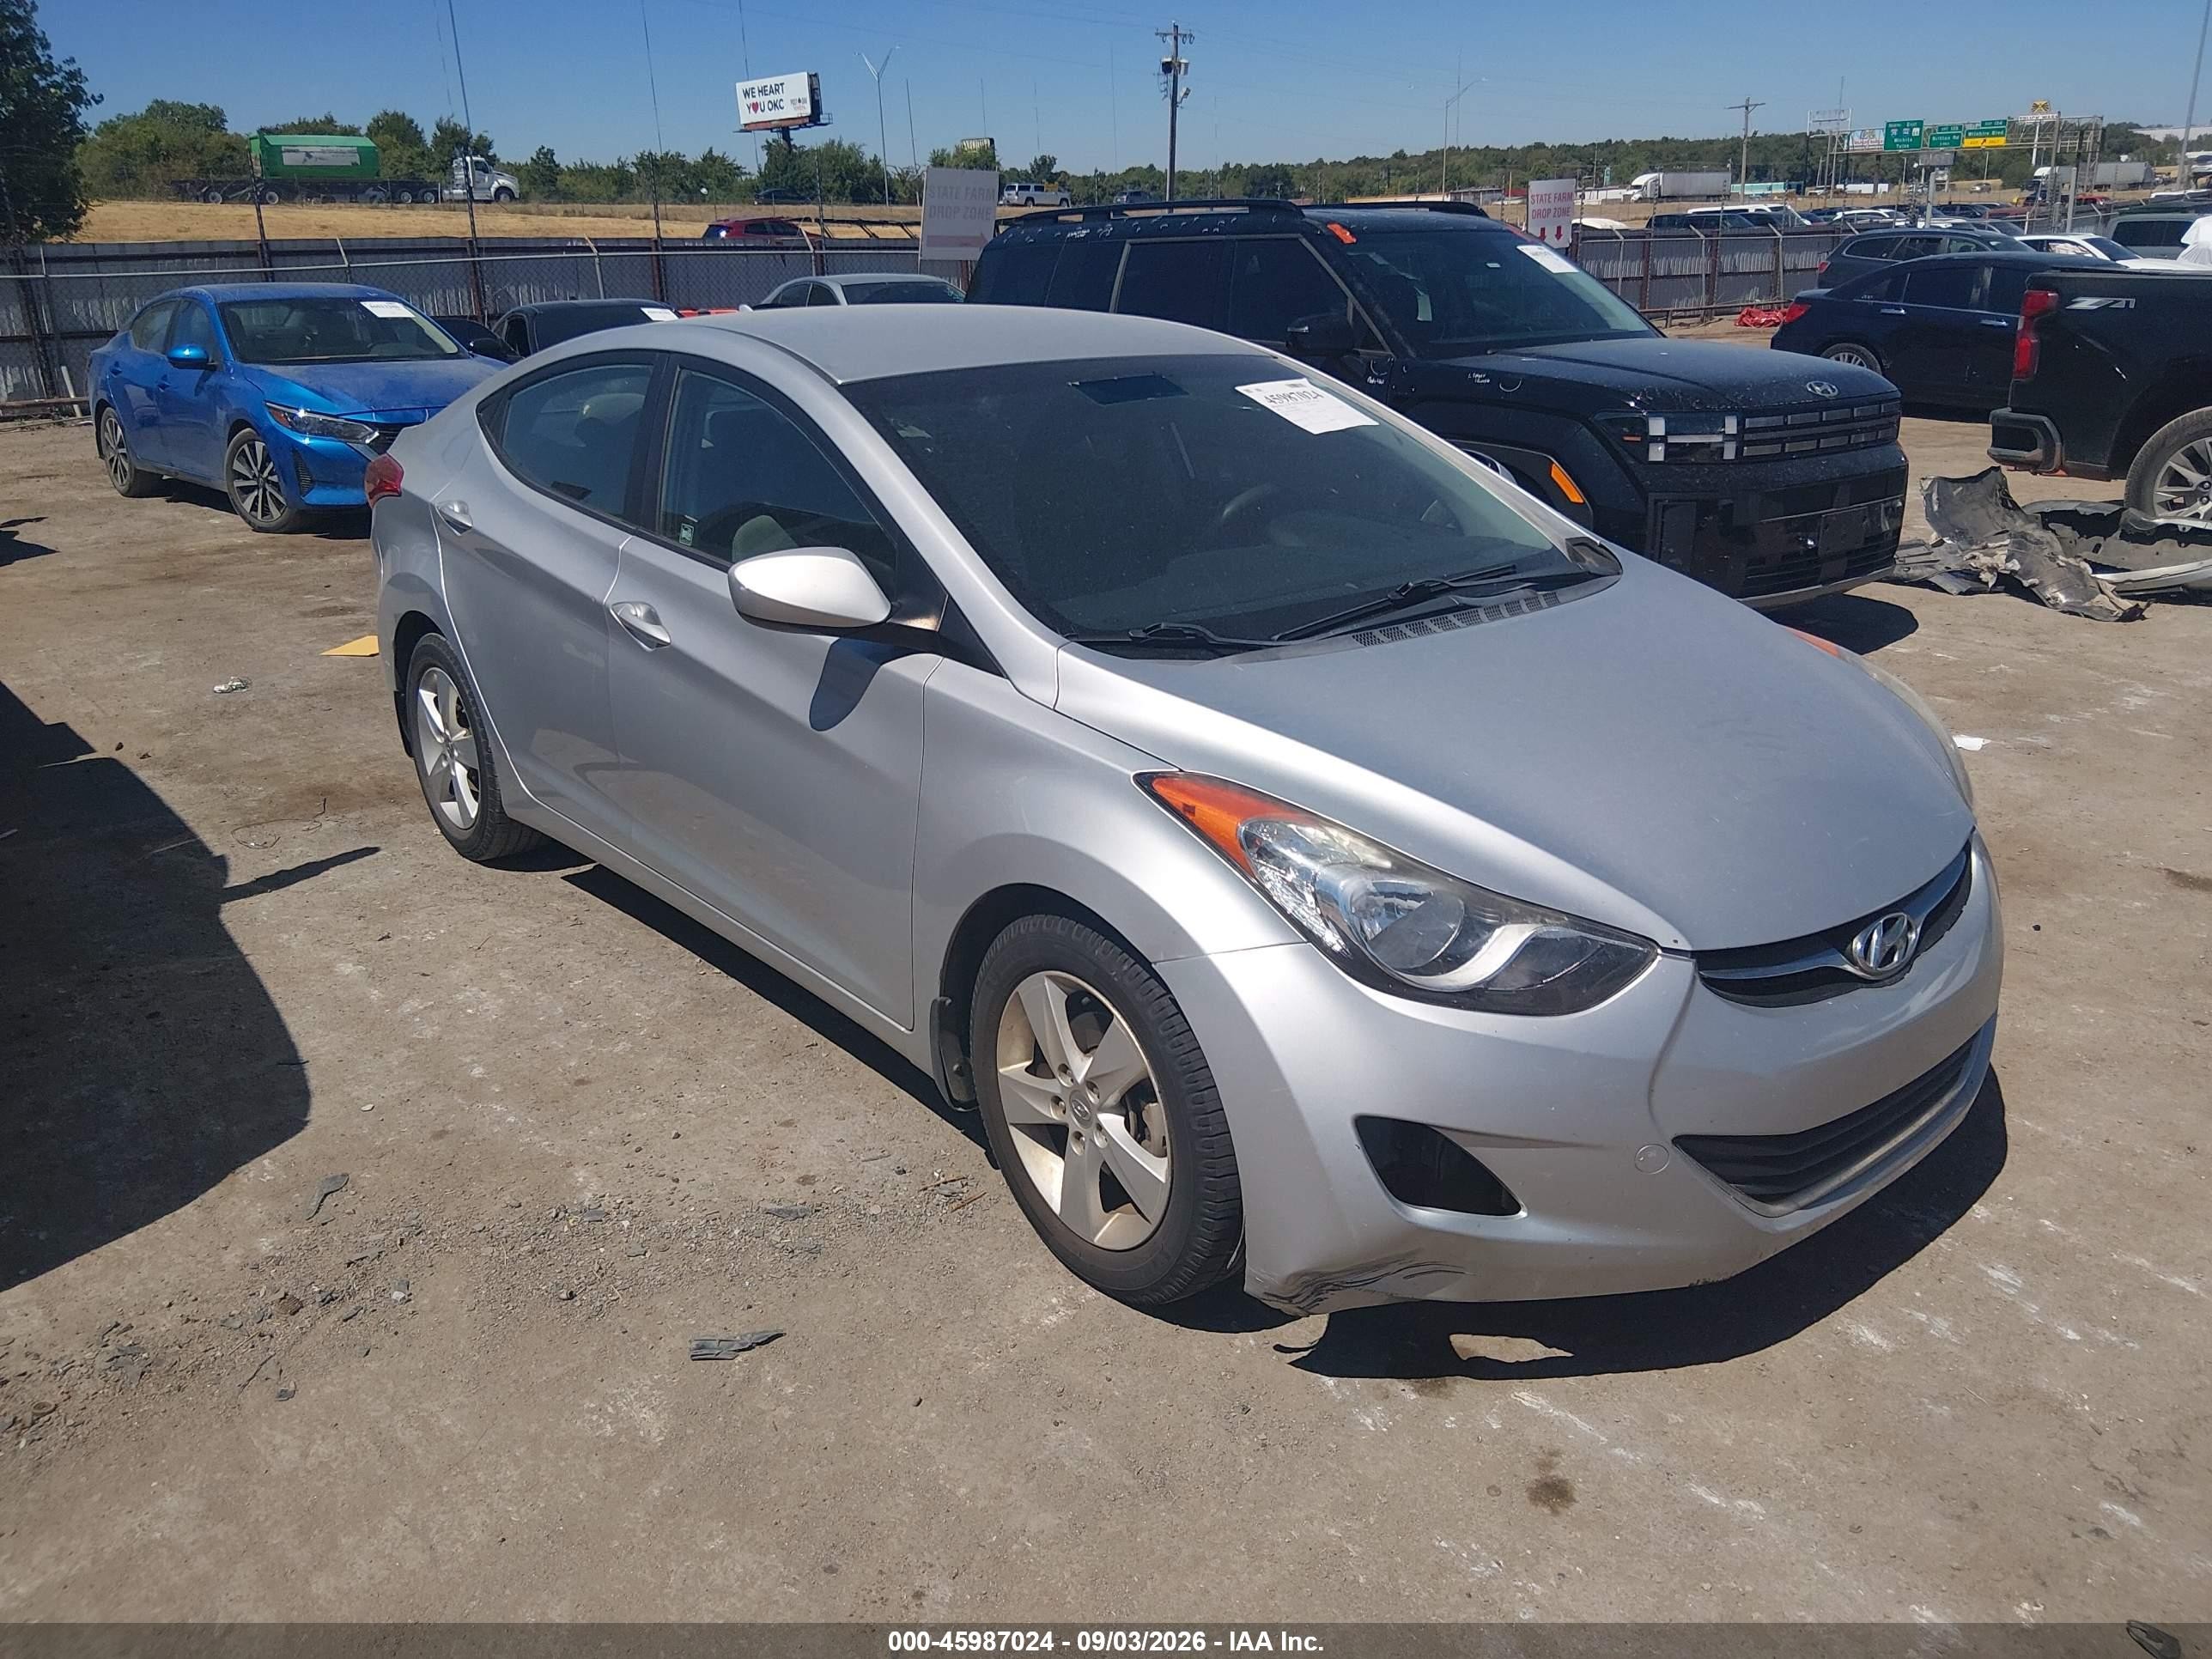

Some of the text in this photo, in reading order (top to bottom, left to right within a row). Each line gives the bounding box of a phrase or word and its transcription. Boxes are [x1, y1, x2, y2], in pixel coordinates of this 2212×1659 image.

[742, 82, 785, 99] WE HEART
[768, 99, 785, 112] OKC
[929, 185, 995, 202] STATE FARM
[1531, 191, 1573, 205] STATE FARM
[929, 205, 992, 221] DROP ZONE
[1532, 206, 1571, 220] DROP ZONE
[2065, 296, 2136, 310] Z71
